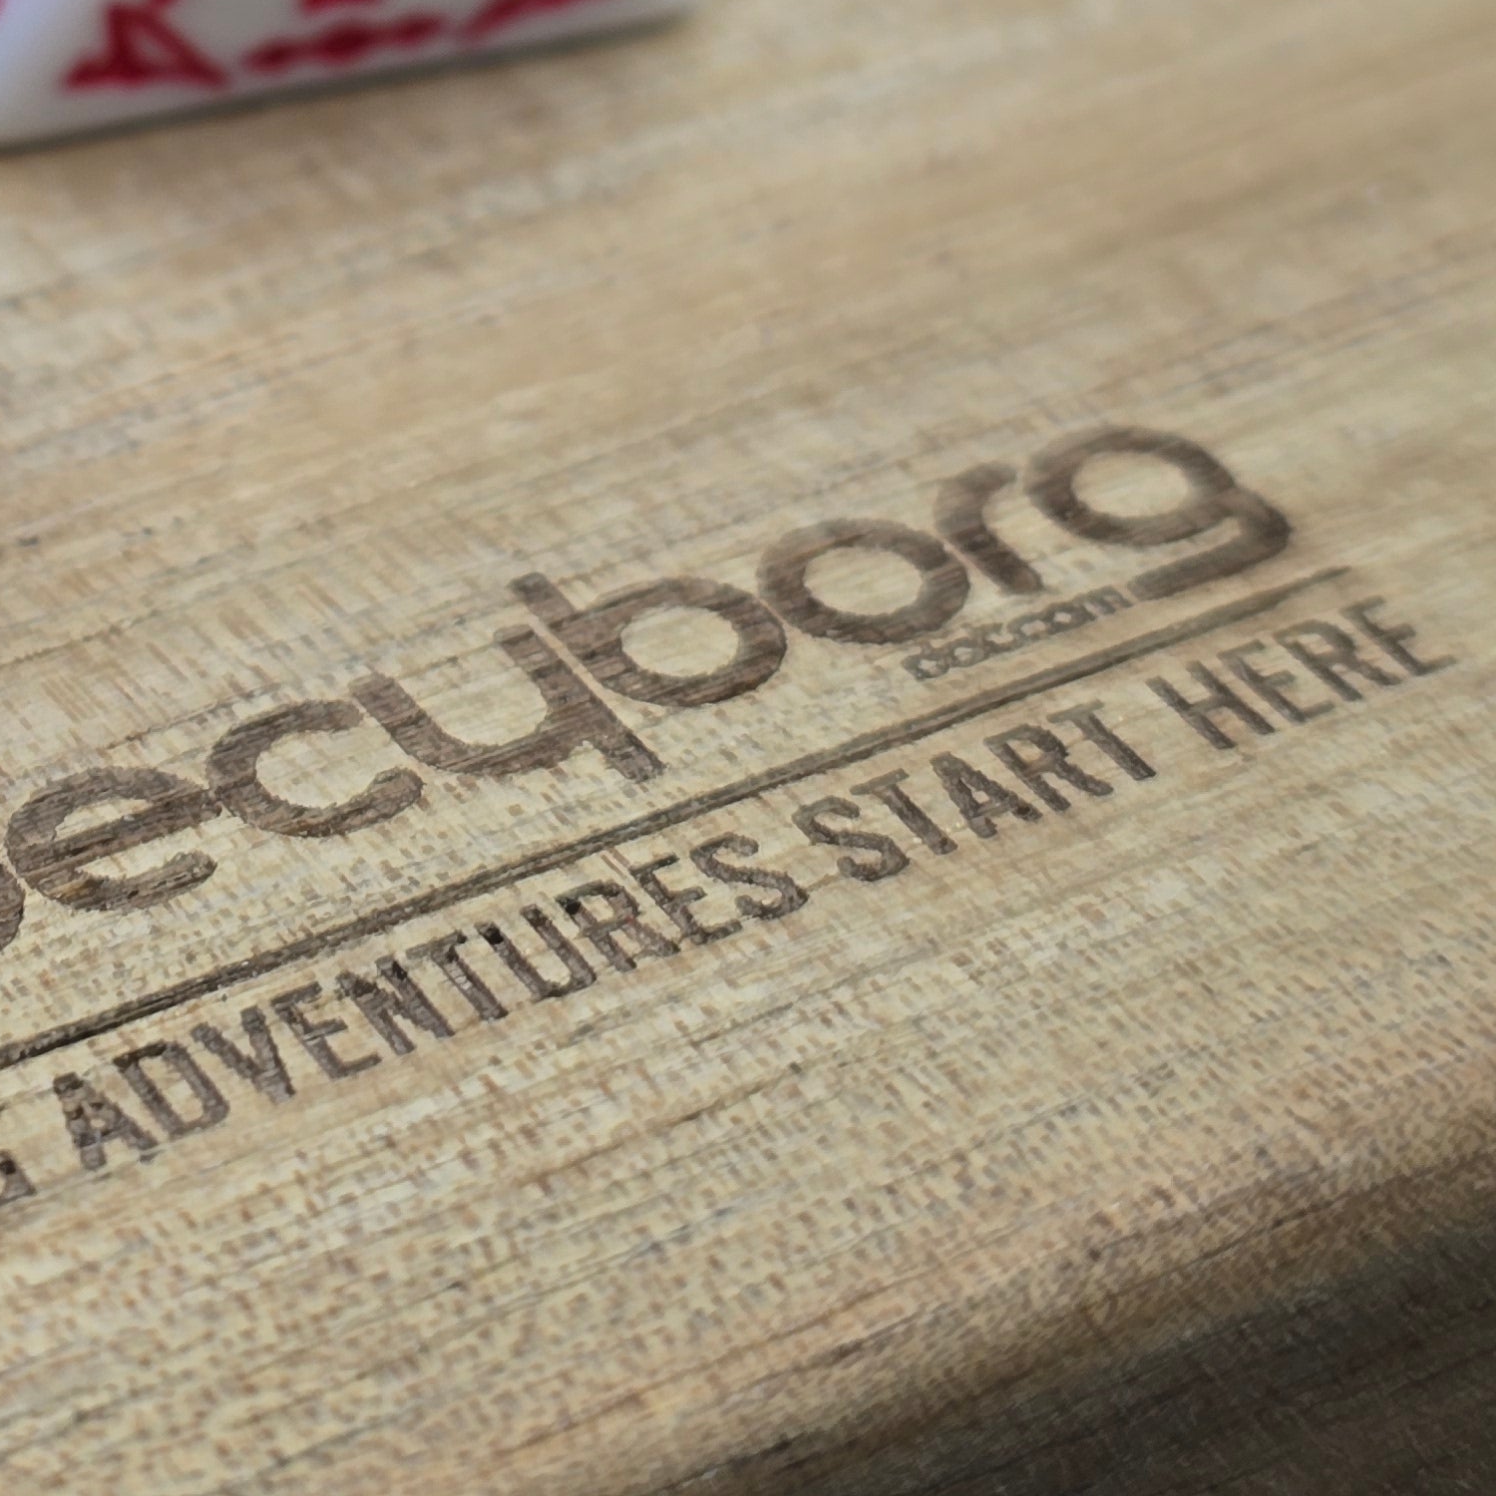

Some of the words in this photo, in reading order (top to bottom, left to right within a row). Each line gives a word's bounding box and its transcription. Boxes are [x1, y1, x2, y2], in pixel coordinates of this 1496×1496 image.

[53, 828, 809, 1168] ADVENTURES
[791, 701, 1157, 883] START
[1146, 594, 1456, 751] HERE
